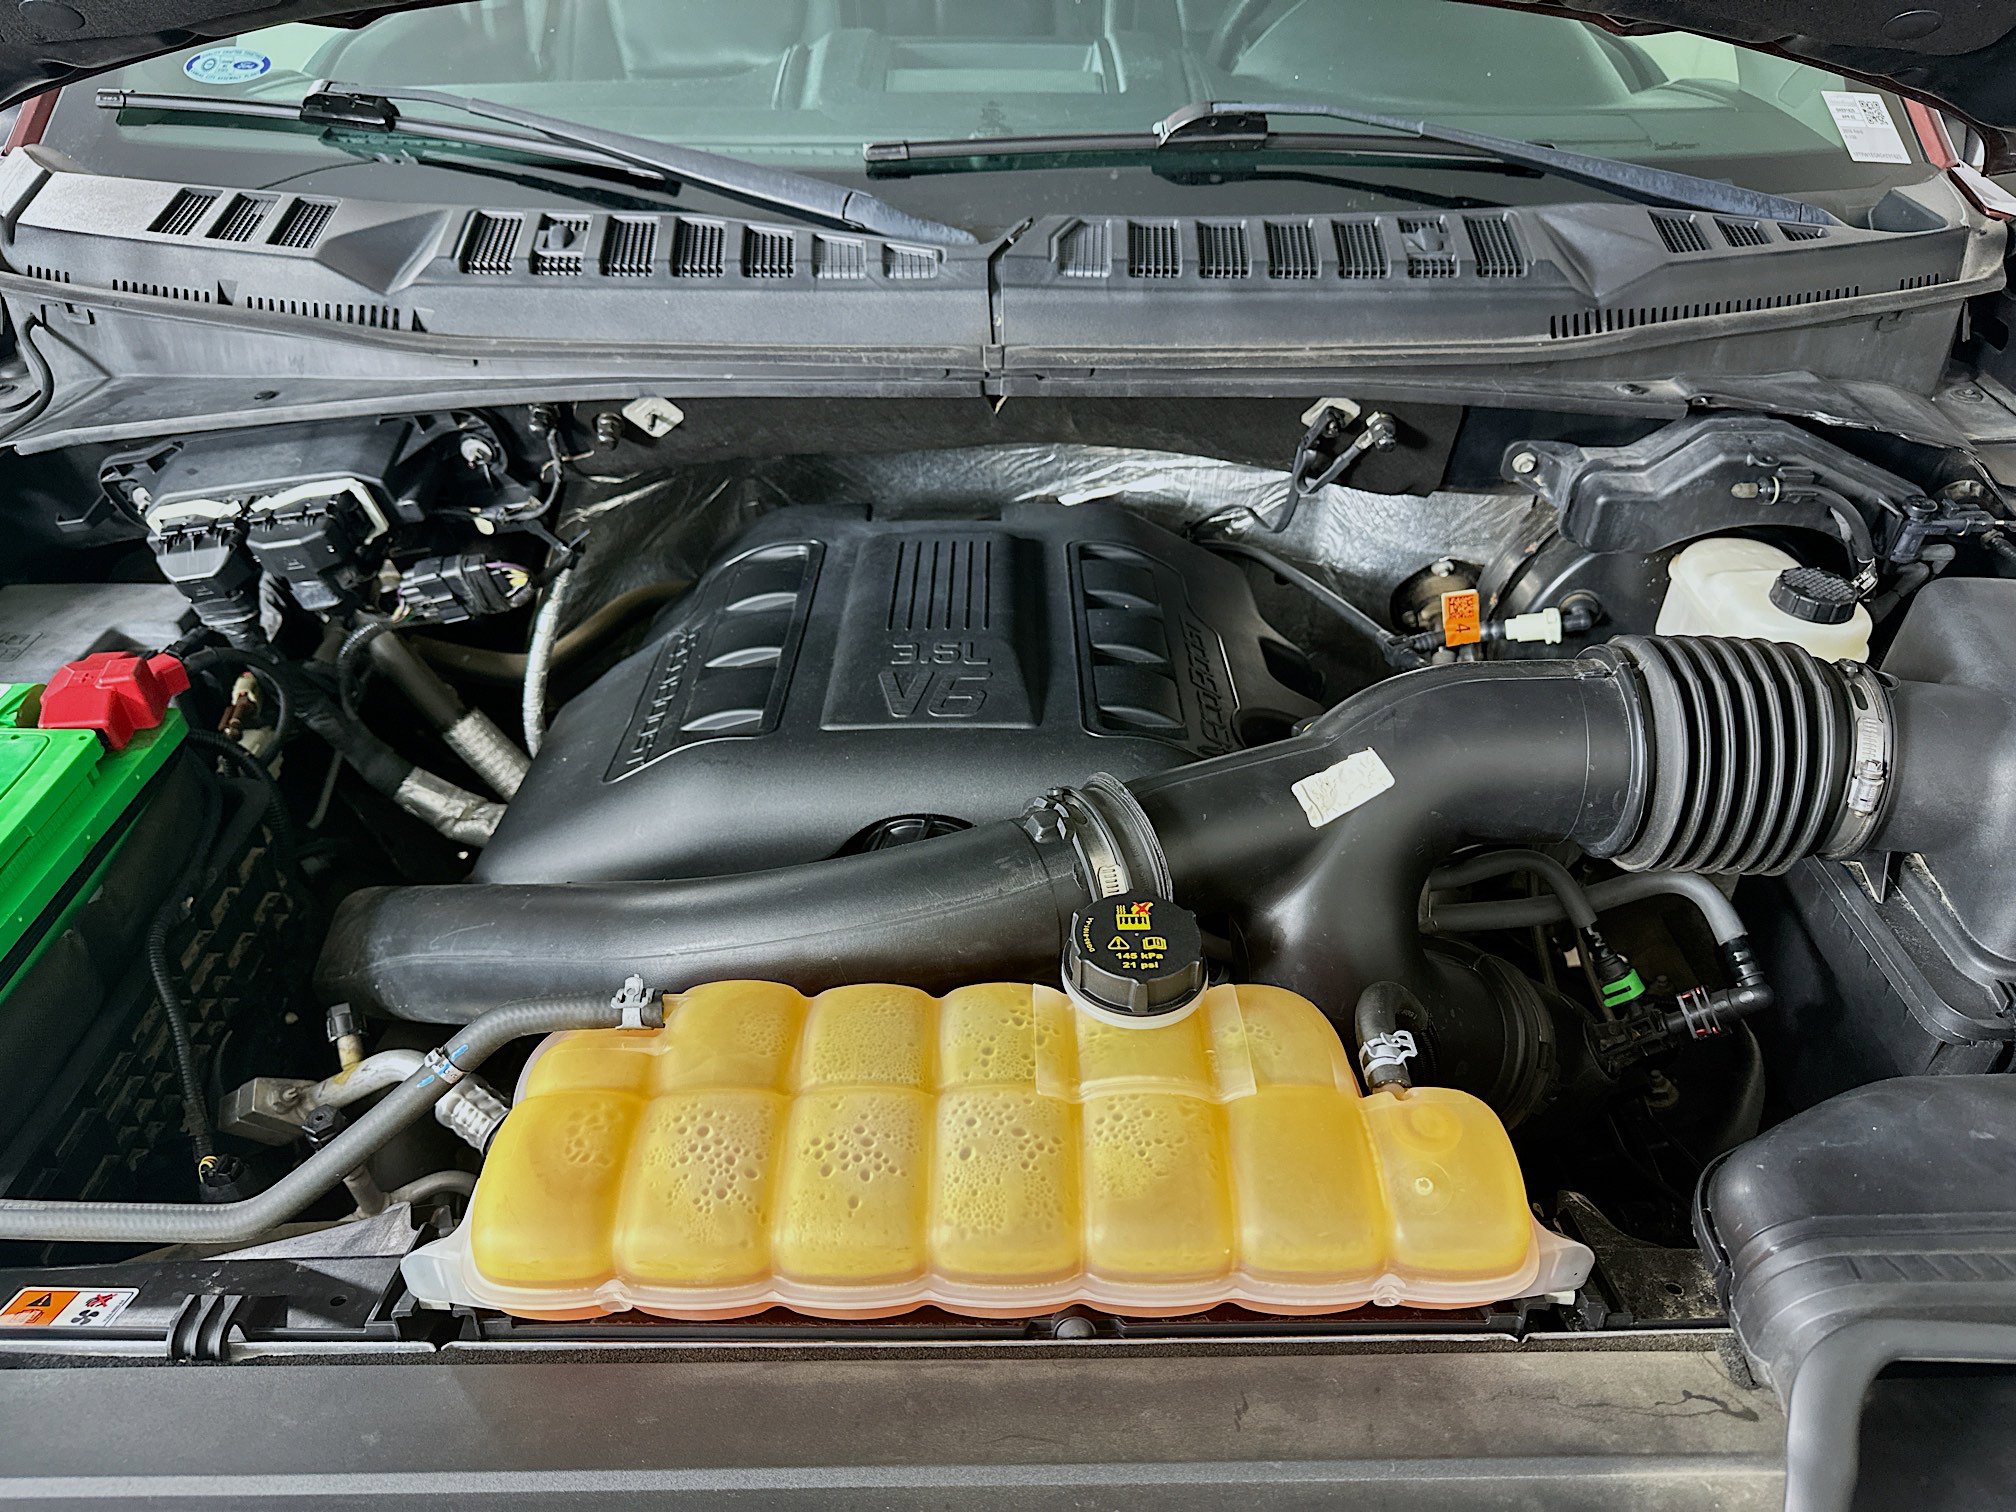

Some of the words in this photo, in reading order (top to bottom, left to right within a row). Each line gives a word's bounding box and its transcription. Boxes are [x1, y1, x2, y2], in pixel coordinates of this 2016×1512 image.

[891, 641, 991, 665] 3.5L
[878, 670, 994, 718] V6
[1140, 952, 1164, 960] kPa
[1122, 961, 1137, 969] 21
[1140, 961, 1159, 970] psi
